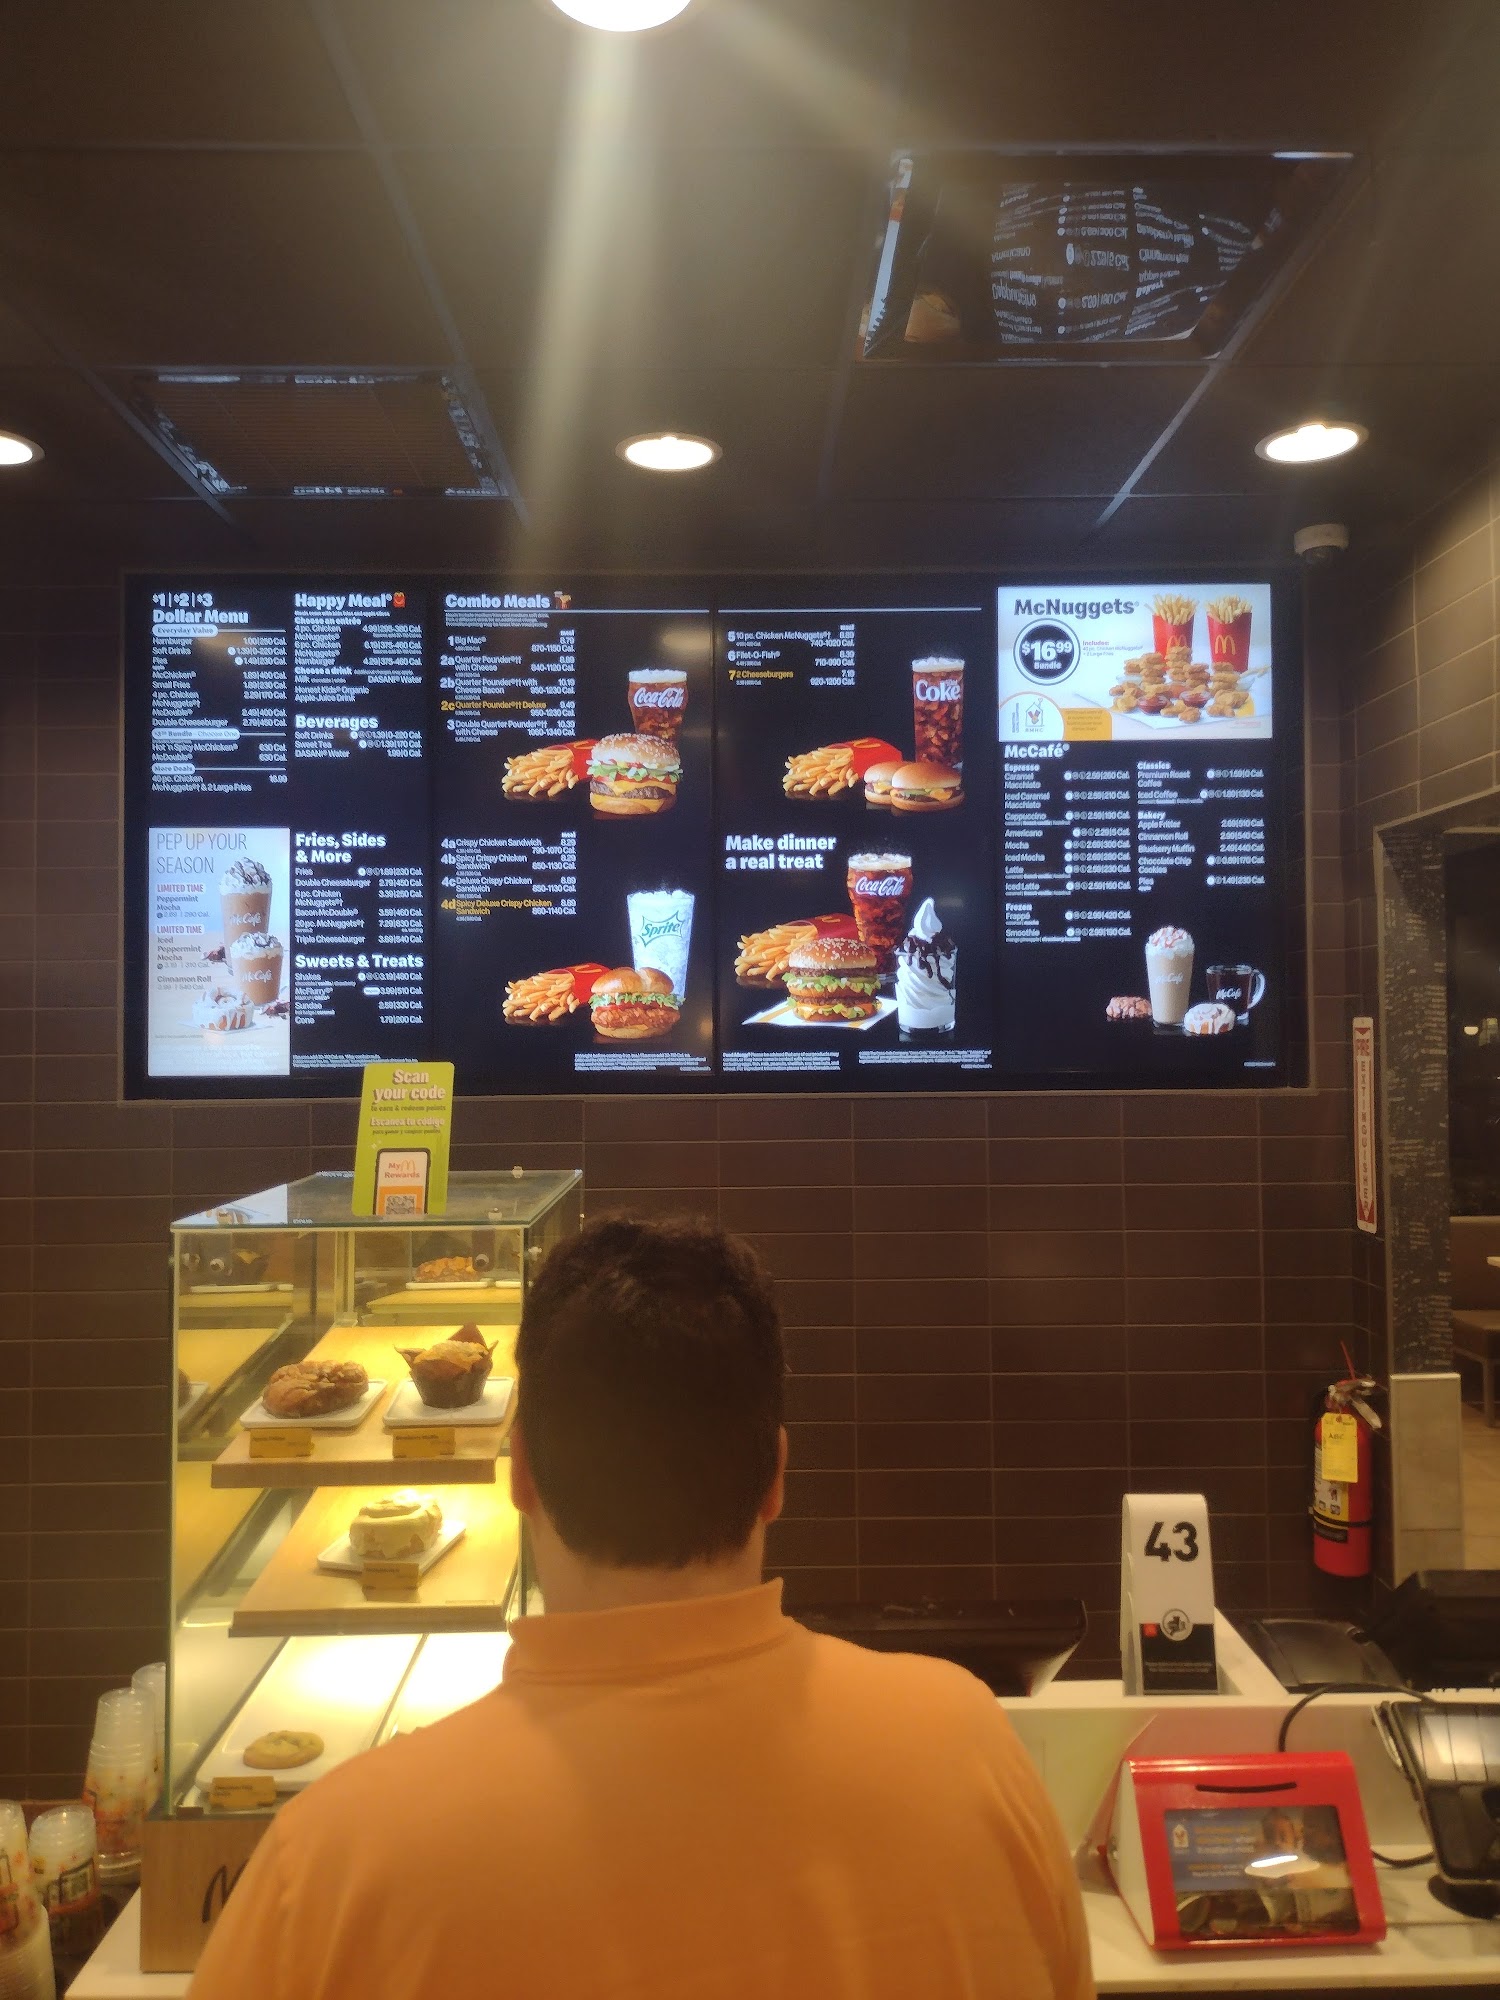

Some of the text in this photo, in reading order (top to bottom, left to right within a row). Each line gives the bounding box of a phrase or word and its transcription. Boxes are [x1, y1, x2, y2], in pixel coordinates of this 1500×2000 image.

[295, 594, 392, 610] Happy Meal®
[446, 594, 550, 608] Combo Meals
[153, 609, 248, 623] Dollar Menu
[448, 636, 466, 646] 1 Big
[728, 631, 735, 642] 5
[756, 632, 784, 640] Chicken
[440, 655, 480, 665] 2a Quarter
[728, 651, 735, 661] 6
[1034, 661, 1062, 670] Bundle
[729, 670, 736, 680] 7
[742, 671, 793, 680] Cheeseburgers
[440, 678, 454, 688] 2b
[456, 678, 480, 686] Quarter
[456, 686, 504, 694] Cheese Bacon
[915, 679, 960, 702] Coke
[441, 701, 455, 710] 2c
[295, 715, 379, 730] Beverages
[447, 720, 507, 730] 3 Double Quarter
[1005, 764, 1040, 772] Espresso
[1138, 812, 1166, 820] Bakery
[156, 833, 247, 850] PEP UP YOUR
[296, 832, 386, 849] Fries, Sides
[441, 838, 456, 849] 4a
[456, 839, 478, 847] Crispy
[725, 833, 836, 851] Make dinner
[296, 850, 352, 863] & More
[441, 854, 456, 864] 4b
[456, 855, 475, 863] Spicy
[476, 855, 498, 863] Crispy
[725, 854, 823, 870] a real treat
[156, 857, 214, 874] SEASON
[456, 862, 490, 870] Sandwich
[442, 877, 456, 887] 4c
[481, 877, 503, 886] Crispy
[855, 876, 906, 896] Coca-Cola
[157, 884, 203, 892] LIMITED TIME
[441, 899, 456, 910] 4d
[456, 900, 475, 908] Spicy
[501, 900, 522, 908] Crispy
[1006, 903, 1032, 911] Frozen
[641, 921, 681, 939] Sprite
[295, 955, 424, 967] Sweets & Treats
[393, 1069, 429, 1084] Scan
[373, 1084, 445, 1104] your code
[371, 1117, 405, 1126] Escanea
[406, 1118, 416, 1126] tu
[1144, 1521, 1199, 1562] 43
